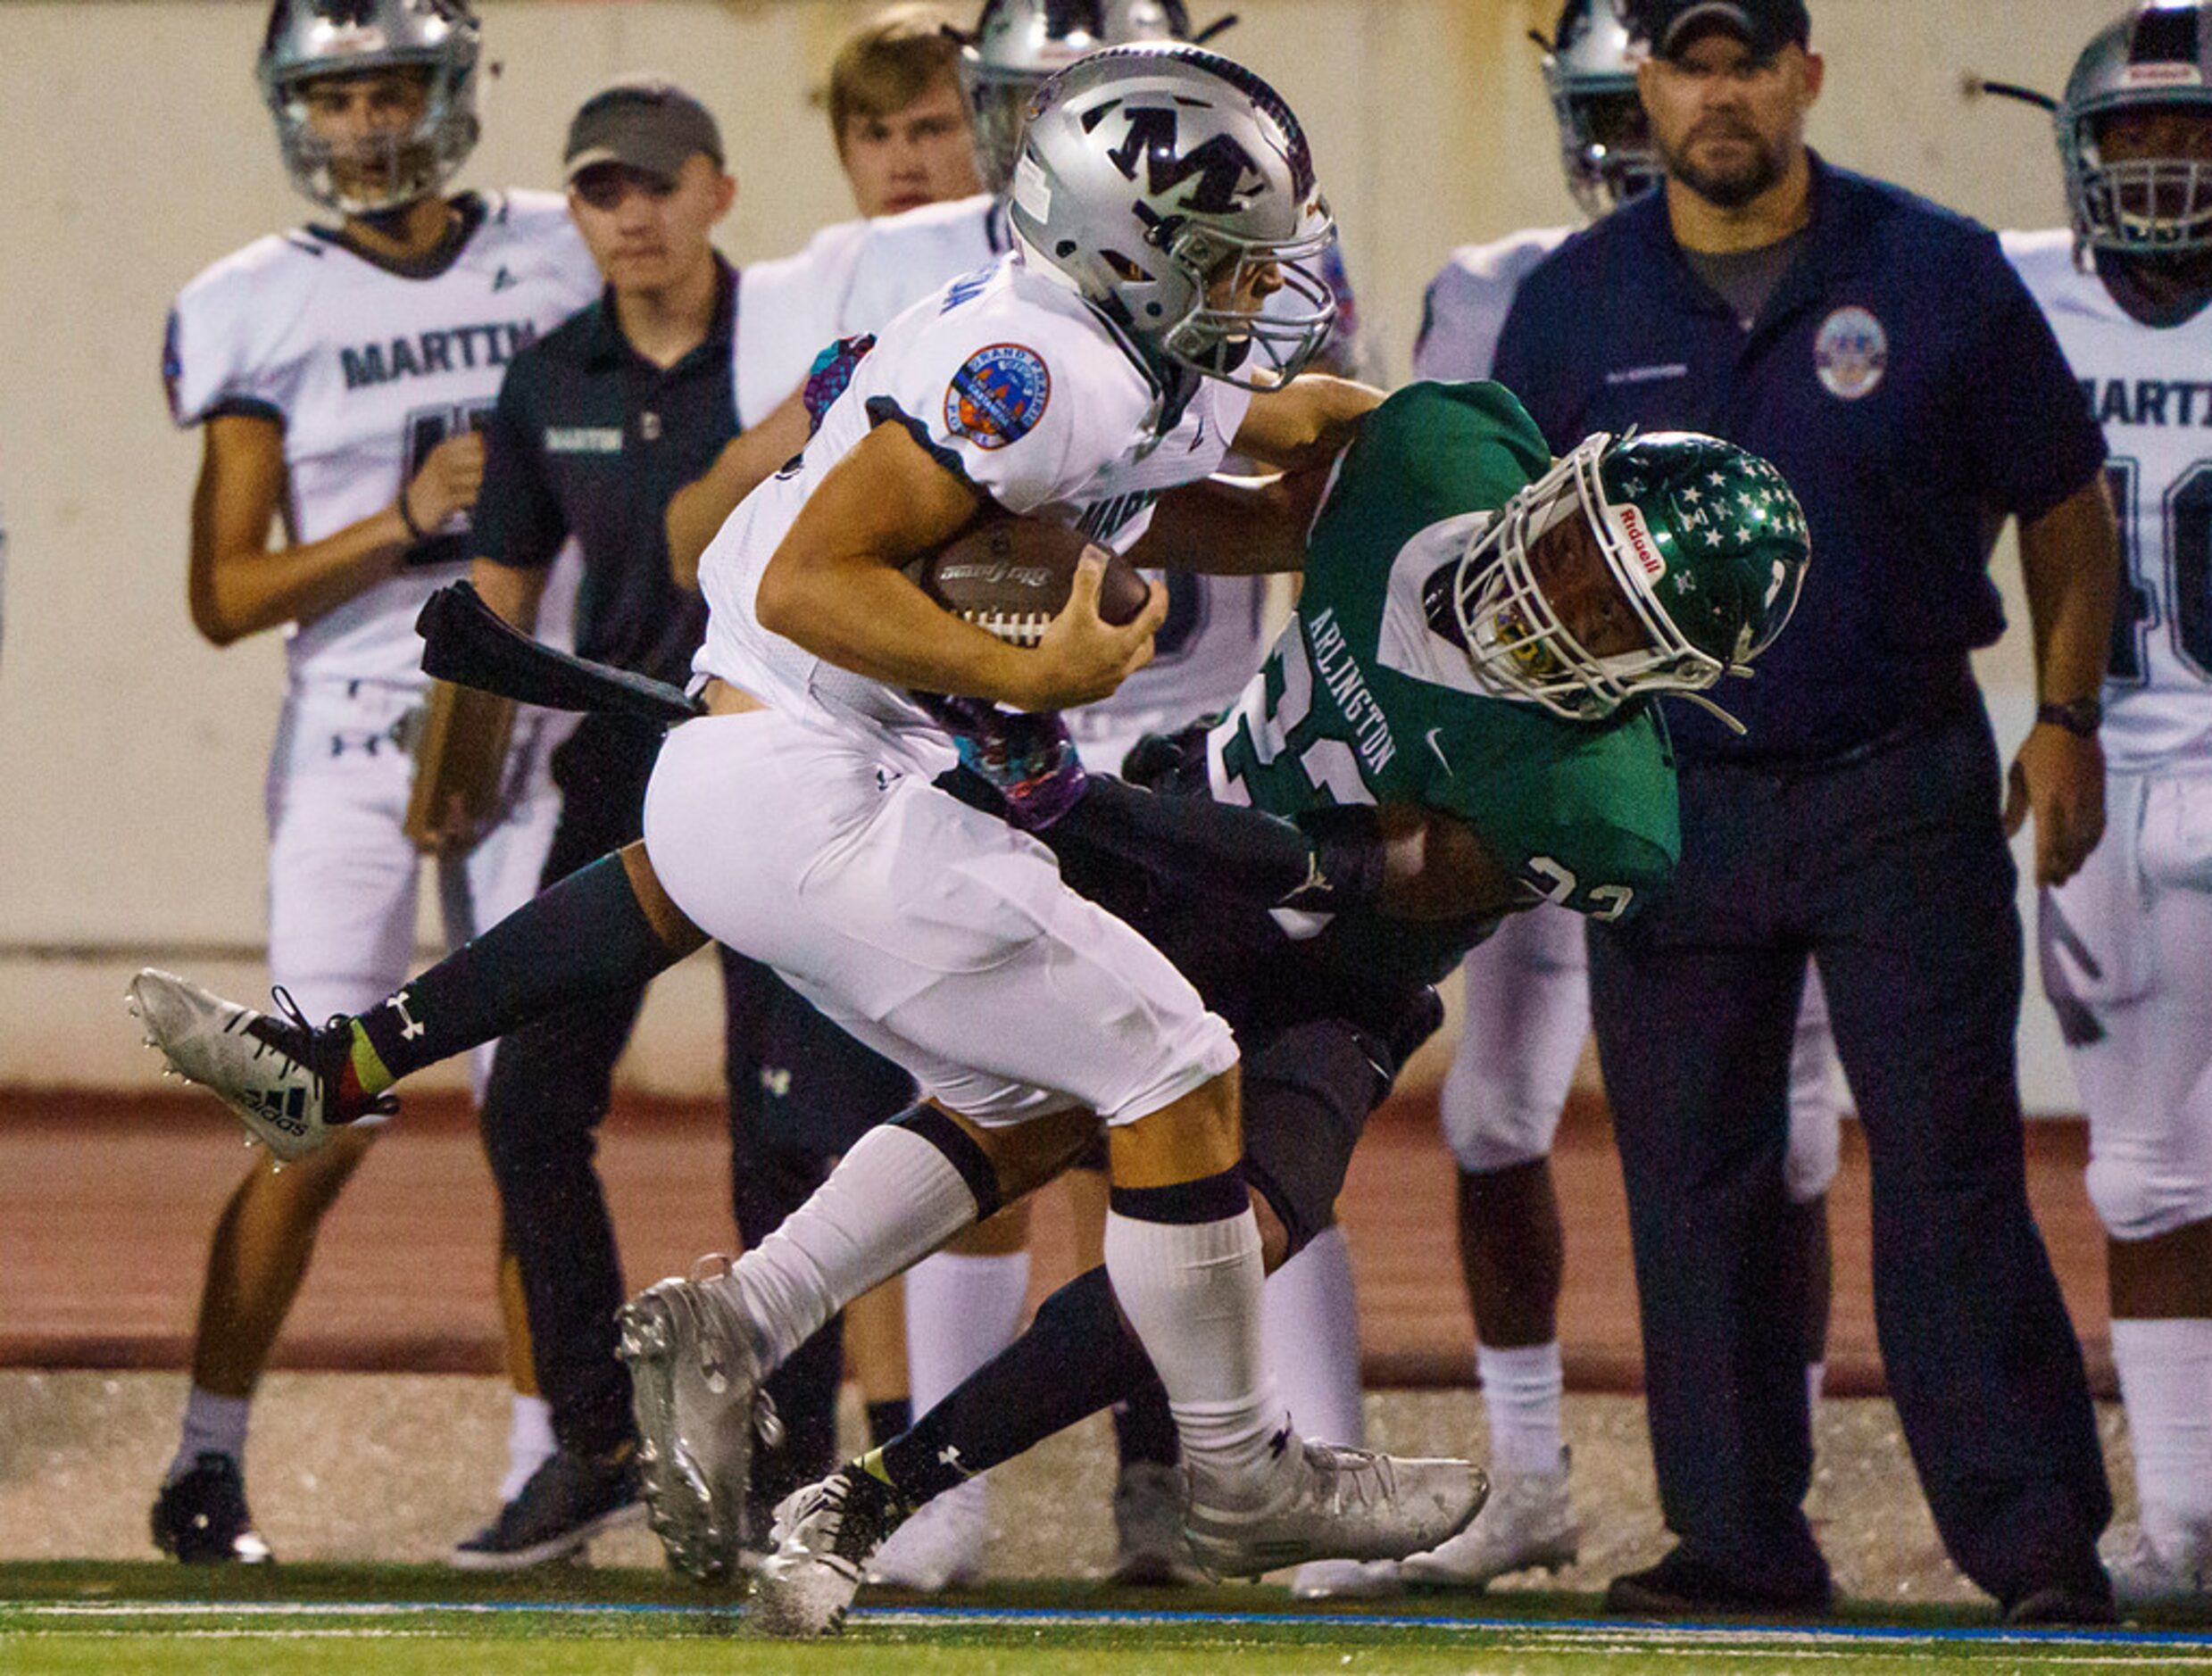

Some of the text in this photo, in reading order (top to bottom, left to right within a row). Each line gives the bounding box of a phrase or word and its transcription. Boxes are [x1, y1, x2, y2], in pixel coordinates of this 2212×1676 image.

[1076, 488, 1158, 541] MAR
[1620, 509, 1660, 573] Riddell
[1309, 607, 1396, 775] ARLINGTON
[234, 1090, 309, 1137] adidas
